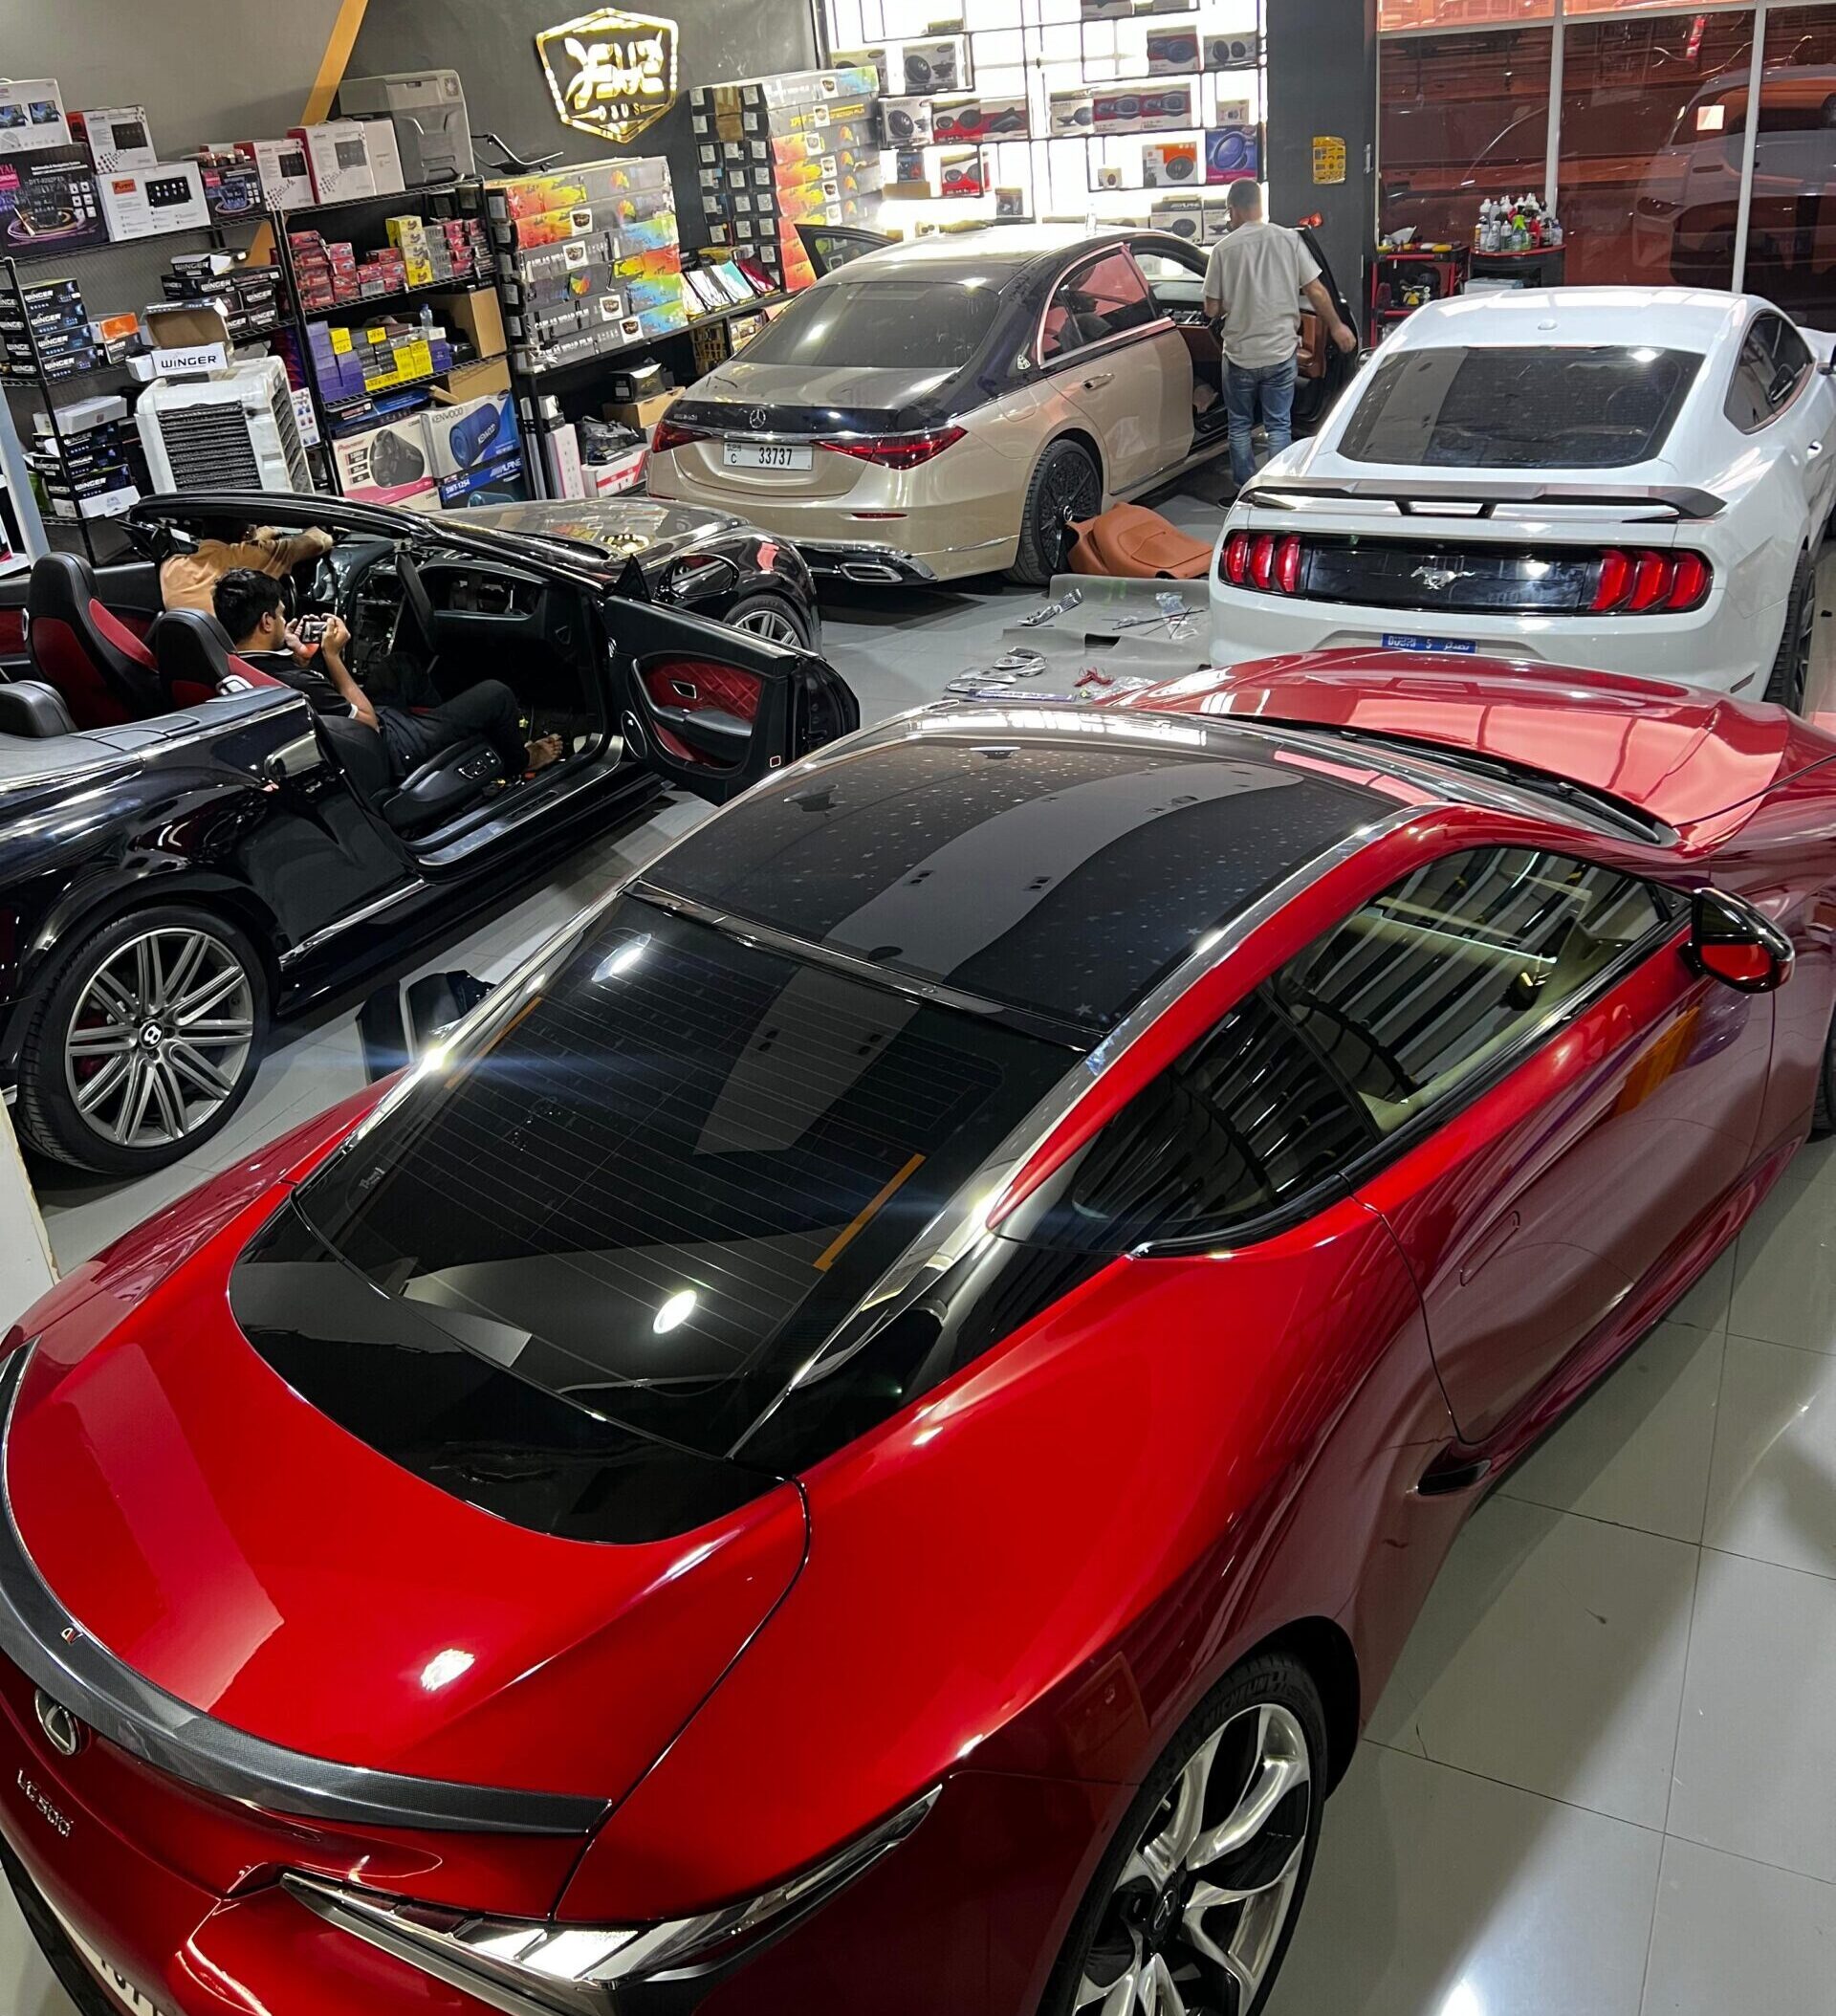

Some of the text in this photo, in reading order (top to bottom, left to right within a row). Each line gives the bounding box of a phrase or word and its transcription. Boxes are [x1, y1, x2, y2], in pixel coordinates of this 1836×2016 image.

[0, 164, 15, 174] YAL
[201, 280, 230, 292] WINGER
[25, 291, 54, 303] WINGER
[31, 313, 61, 326] WINGER
[228, 318, 246, 327] NGER
[38, 336, 69, 348] WINGER
[45, 358, 75, 371] WINGER
[161, 355, 216, 369] WINGER
[731, 448, 793, 466] C 33737
